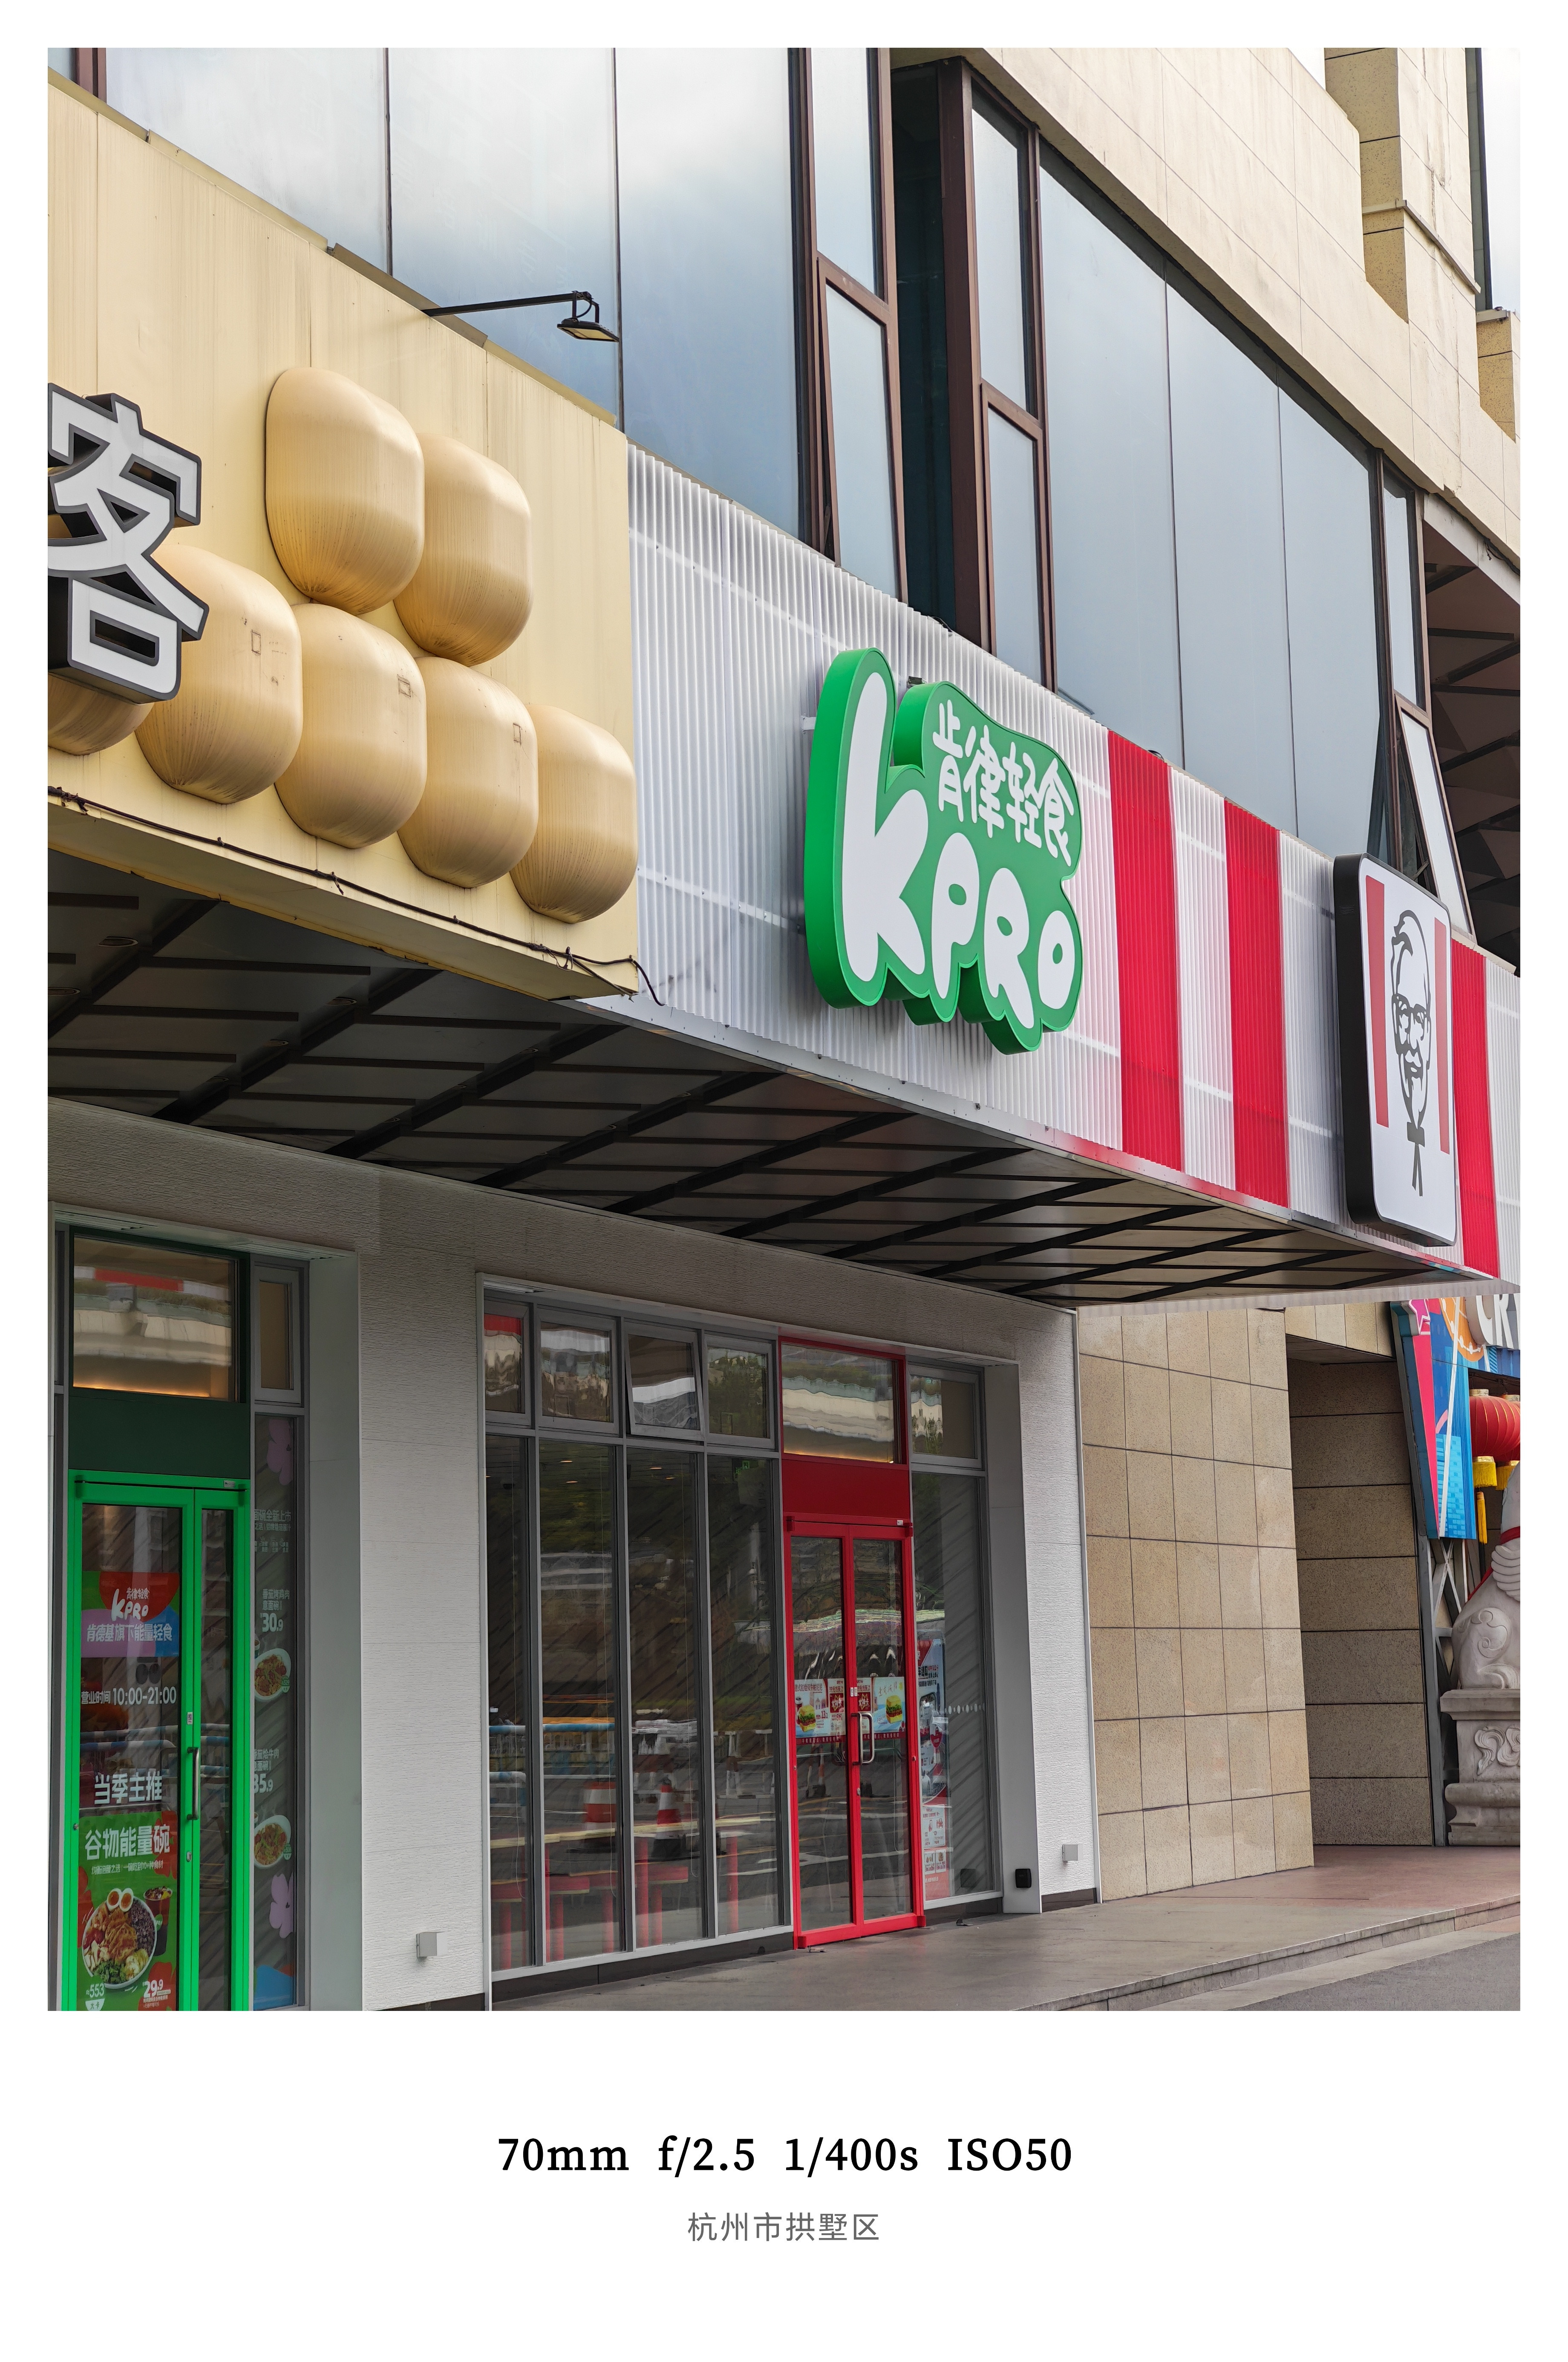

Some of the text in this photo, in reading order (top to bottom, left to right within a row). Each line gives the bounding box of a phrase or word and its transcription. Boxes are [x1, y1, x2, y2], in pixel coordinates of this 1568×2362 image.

[48, 383, 209, 701] 客
[933, 699, 1074, 867] 肯律轻食
[126, 1587, 150, 1600] 肯律轻食
[87, 1623, 173, 1642] 肯德基旗下能量轻食
[81, 1686, 177, 1705] 营业时间 10:00-21:00
[94, 1771, 163, 1805] 当季主推
[85, 1824, 170, 1861] 谷物能量碗
